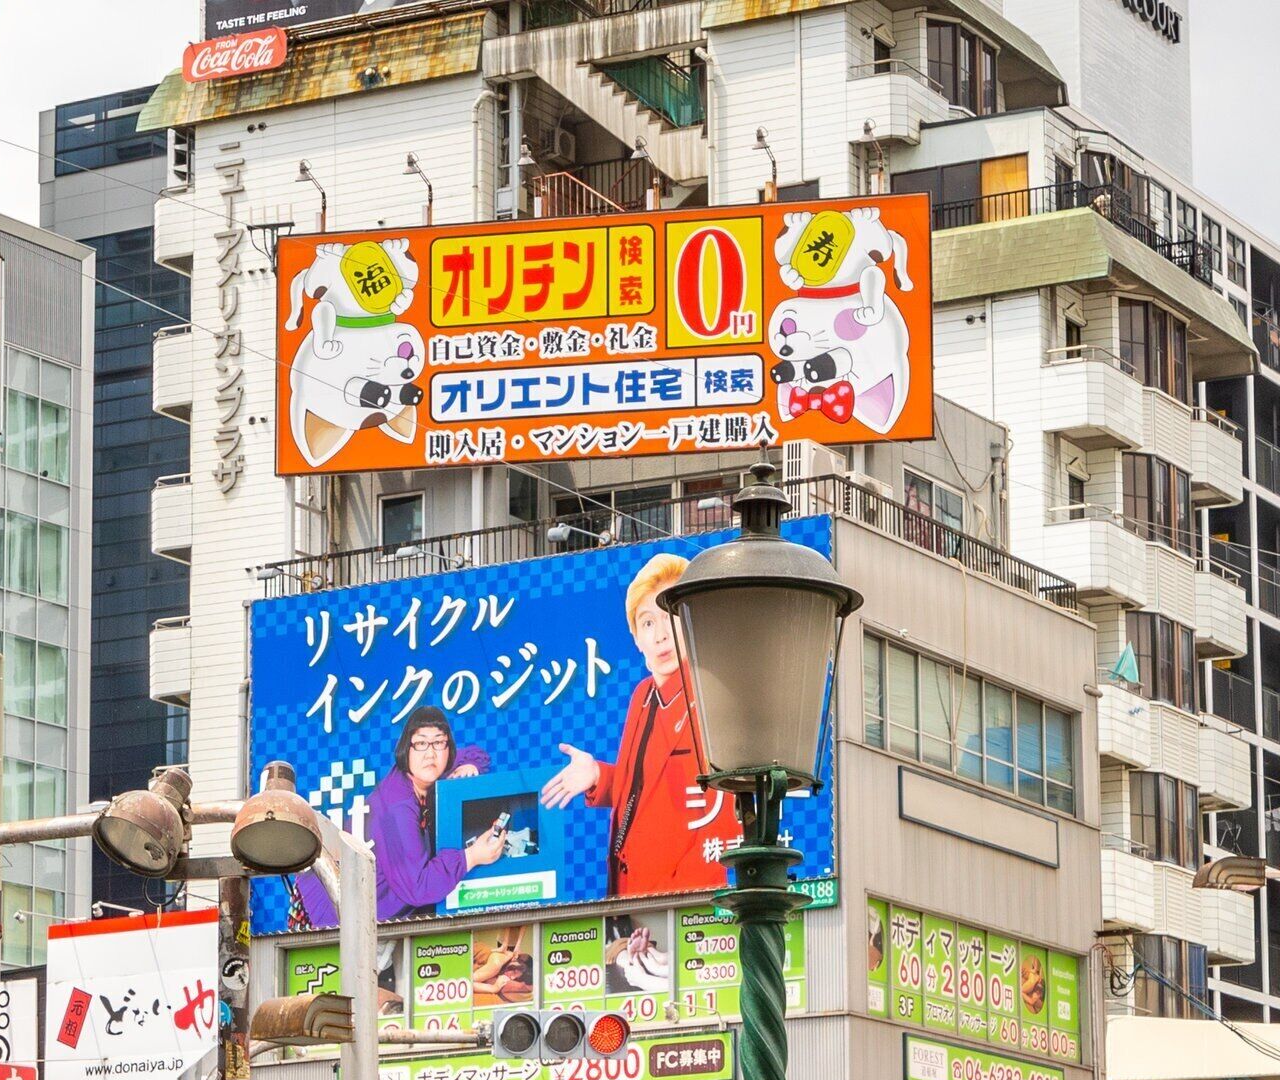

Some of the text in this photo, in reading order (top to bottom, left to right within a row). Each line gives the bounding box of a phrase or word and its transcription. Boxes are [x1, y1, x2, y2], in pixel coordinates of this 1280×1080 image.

[216, 5, 307, 30] TASTE THE FEELING
[215, 38, 239, 51] FROM
[618, 235, 644, 307] 検索
[805, 230, 842, 273] 寿
[355, 260, 395, 299] 福
[441, 241, 596, 318] オリチン
[212, 140, 246, 495] ニューアメリカンプラザ
[431, 327, 655, 362] 自己資金・敷金・礼金
[441, 369, 683, 414] オリエント住宅
[704, 368, 754, 395] 検索
[303, 594, 515, 667] リサイクル
[305, 637, 611, 732] インクのジット
[549, 928, 598, 944] Aromaoil
[891, 913, 1016, 974] ボディマッサージ
[548, 967, 601, 990] ¥3800
[900, 954, 1014, 1013] 60分2800円
[99, 979, 216, 1040] どないや
[898, 994, 914, 1017] 3F
[655, 1045, 722, 1070] FC募集中
[1000, 1019, 1076, 1058] 60分3800円
[85, 1057, 184, 1077] www.donaiya.jp
